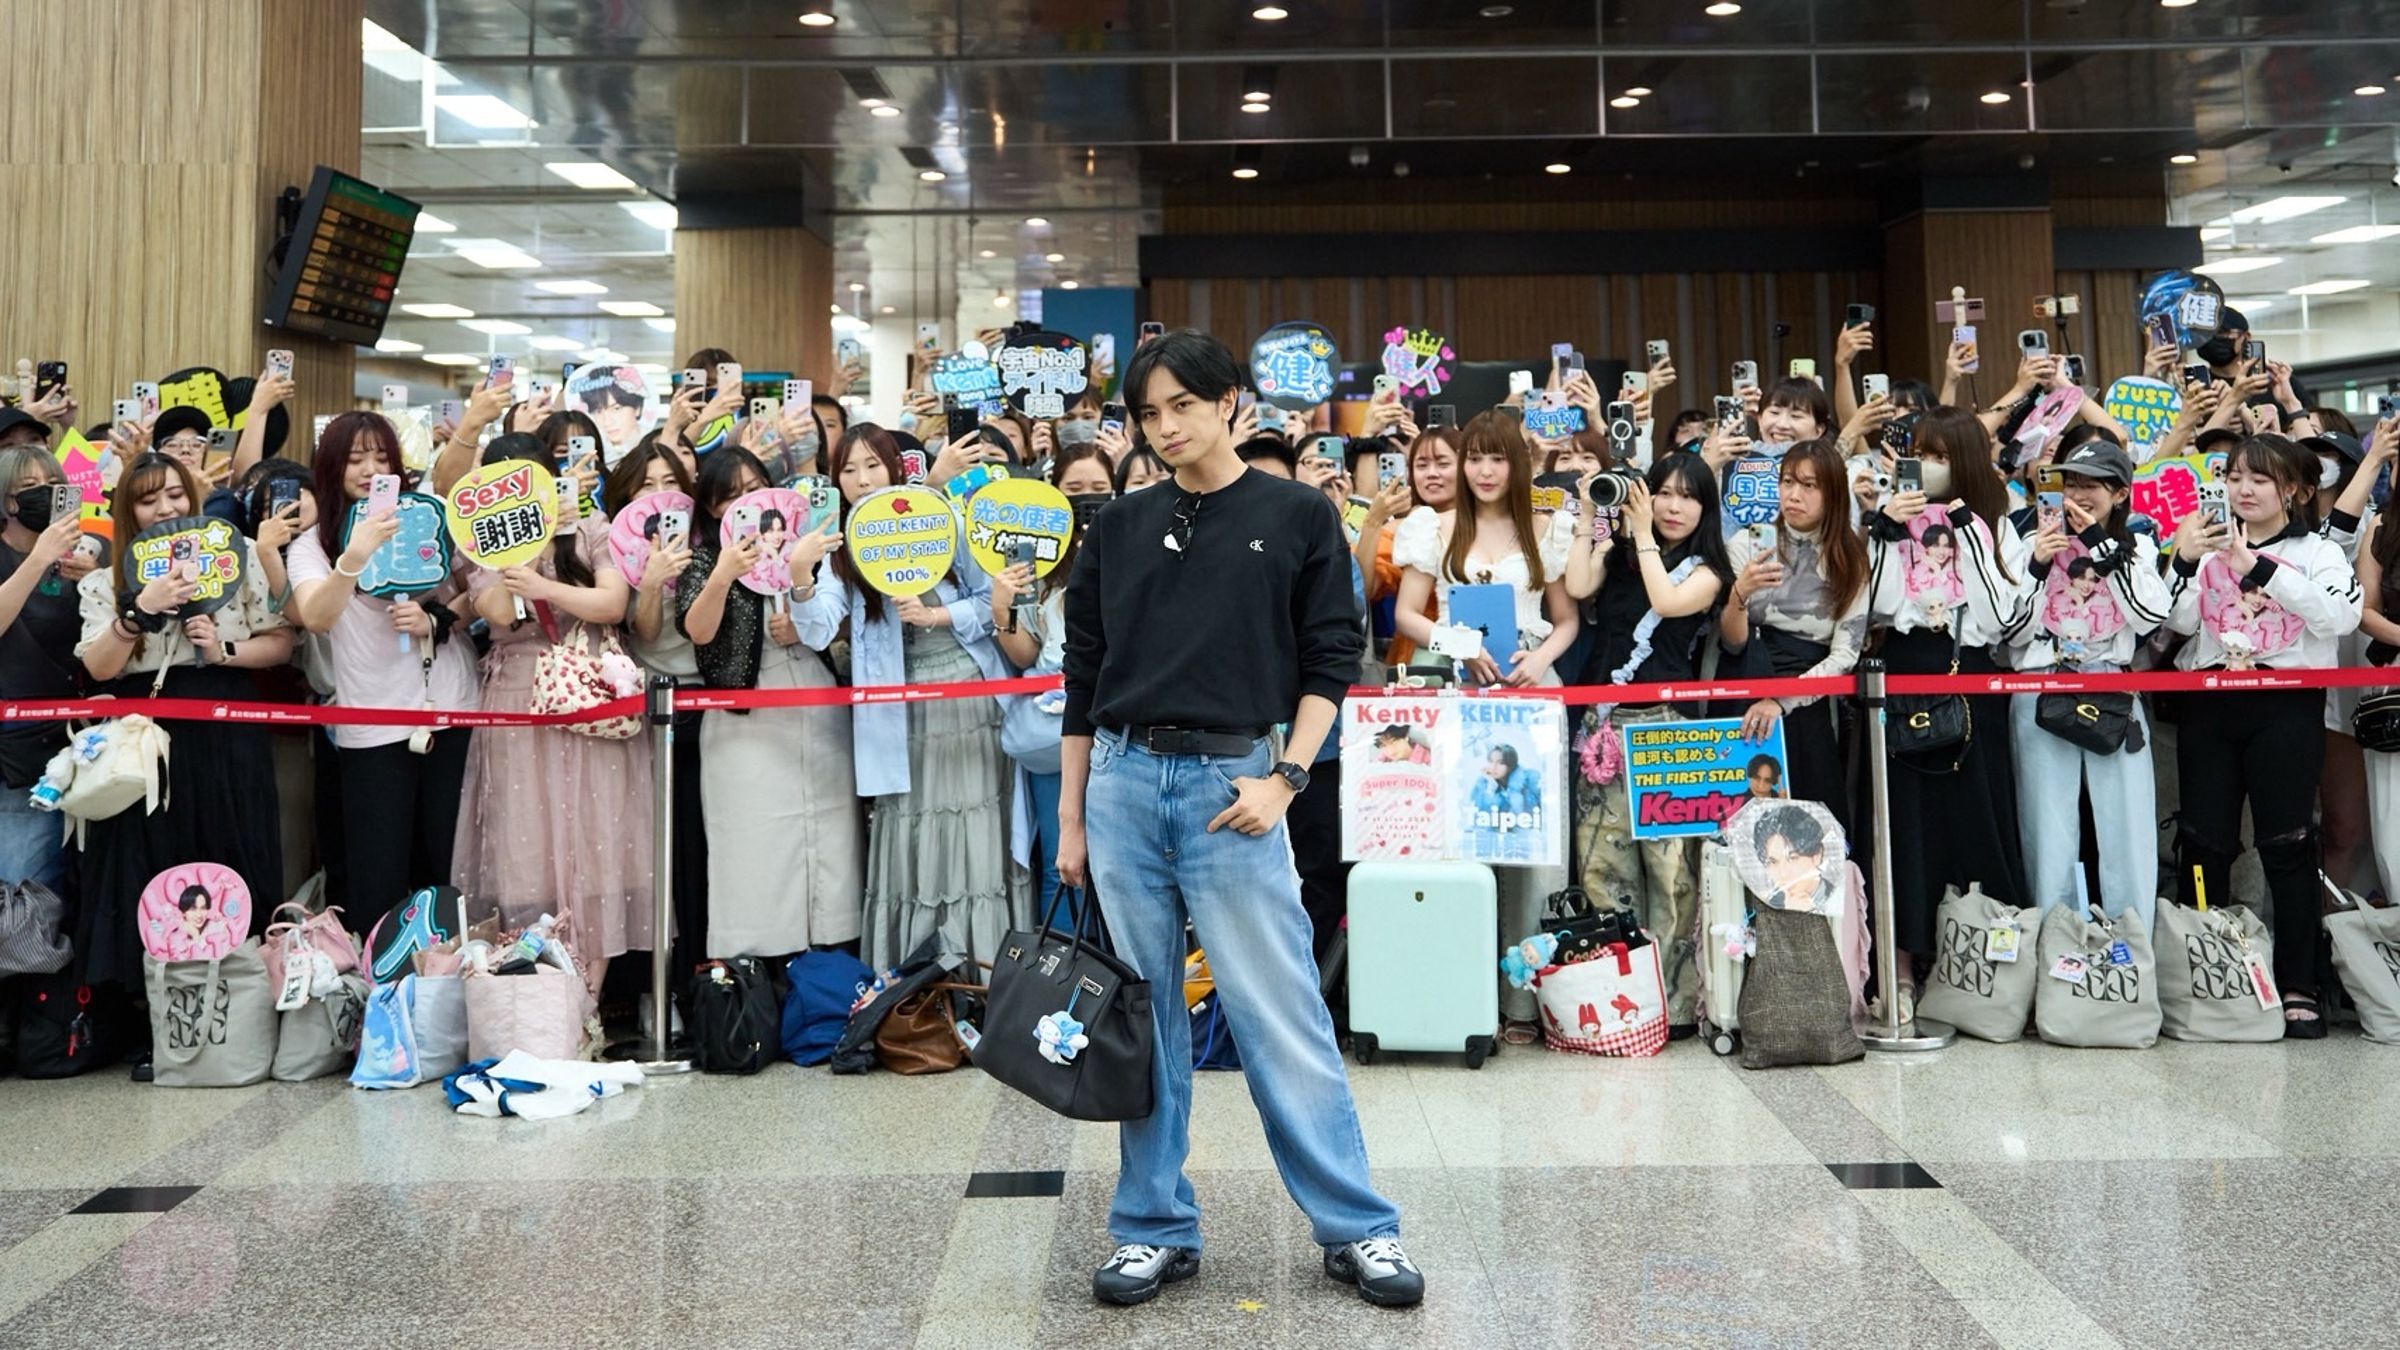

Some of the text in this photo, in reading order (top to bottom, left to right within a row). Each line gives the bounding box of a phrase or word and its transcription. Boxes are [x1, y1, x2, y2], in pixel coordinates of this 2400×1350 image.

[2181, 292, 2218, 328] 健
[947, 359, 985, 372] Love
[1001, 348, 1084, 370] 宇宙No.1
[1004, 371, 1087, 395] アイドル
[1267, 350, 1334, 401] 健人
[2116, 383, 2173, 406] JUST
[1526, 408, 1581, 429] Kenty
[2108, 401, 2180, 426] KENTY
[456, 466, 532, 516] Sexy
[856, 514, 949, 537] LOVE KENTY
[973, 499, 1071, 534] 光の使者
[475, 505, 543, 554] 謝謝
[860, 539, 949, 562] OF MY STAR
[885, 567, 930, 583] 100%
[1357, 704, 1440, 728] Kenty
[1460, 703, 1545, 724] KENTY
[1632, 728, 1723, 745] 圧倒的なOnly
[1632, 747, 1717, 765] 銀河も認める
[1365, 779, 1430, 790] Super IDOL
[1635, 769, 1745, 786] THE FIRST STAR
[1640, 791, 1746, 831] Kenty
